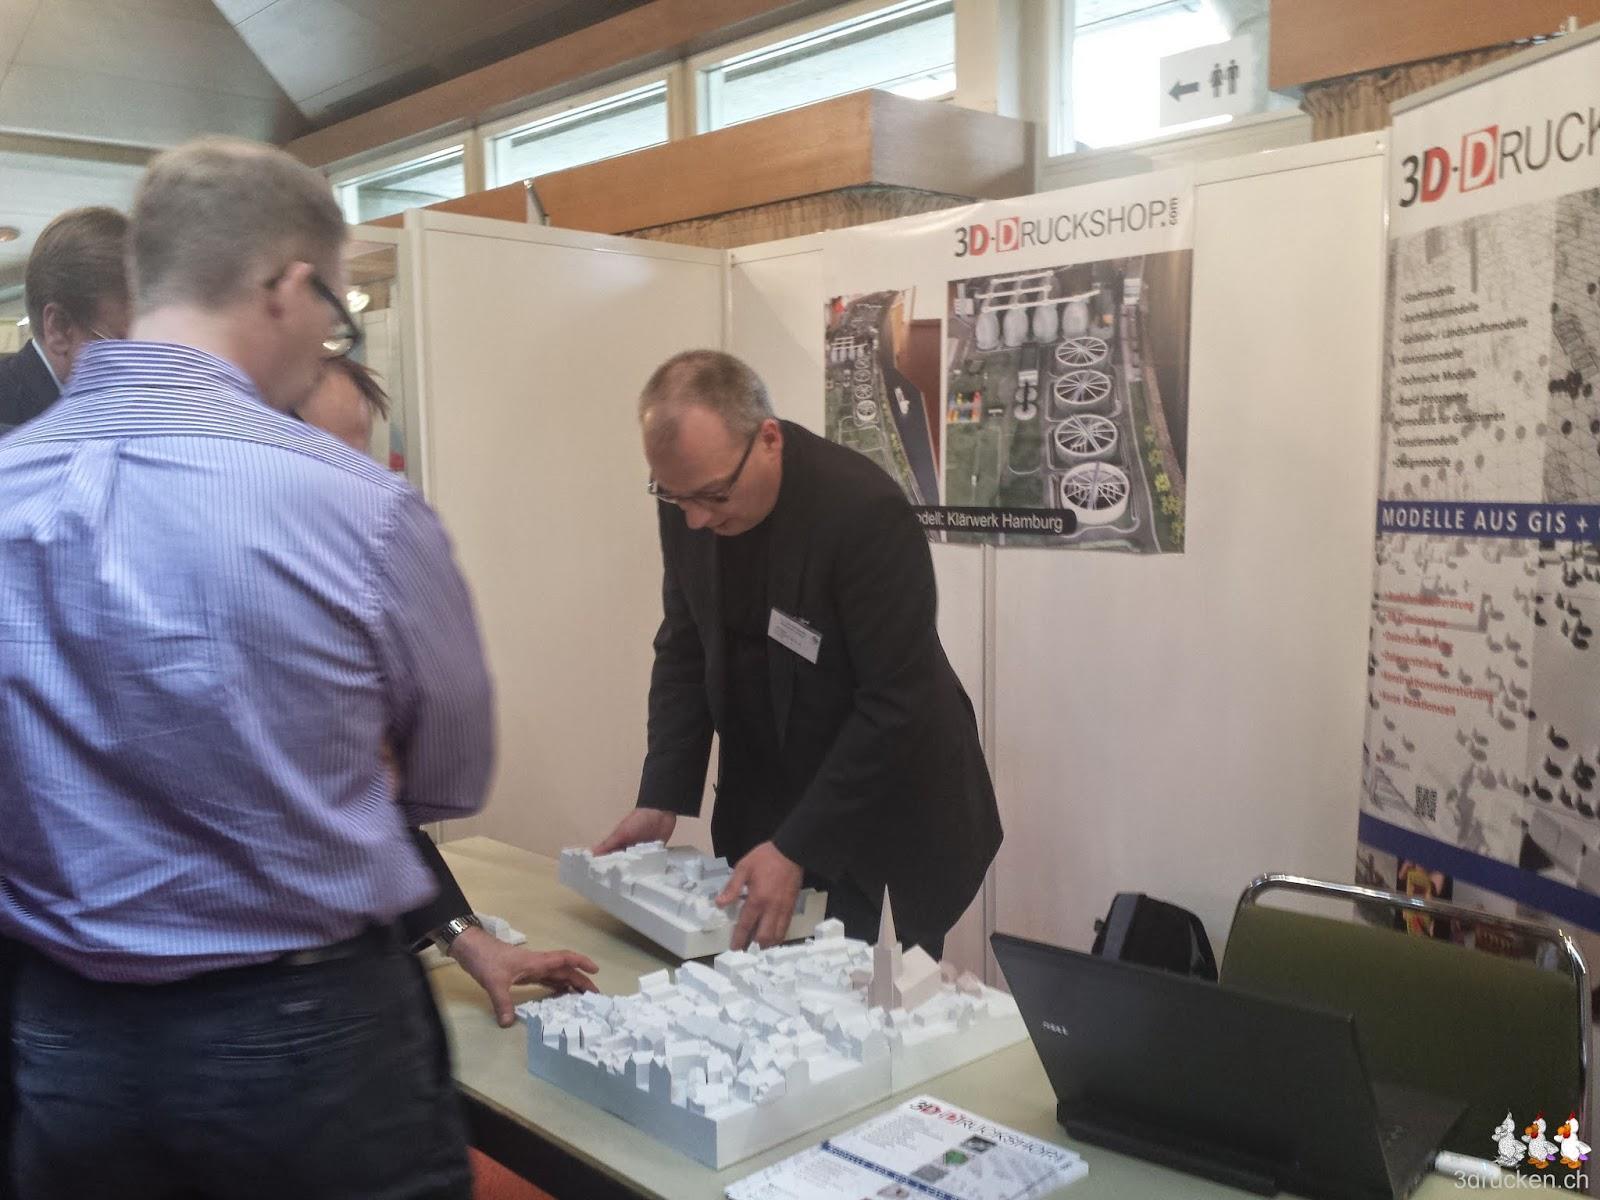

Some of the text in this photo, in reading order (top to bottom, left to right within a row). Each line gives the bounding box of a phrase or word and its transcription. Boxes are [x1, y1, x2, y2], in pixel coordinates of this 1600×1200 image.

[946, 511, 1000, 528] Klärwerk
[1002, 513, 1064, 533] Hamburg
[1382, 507, 1465, 530] MODELLE
[1474, 510, 1517, 532] AUS
[1528, 511, 1567, 534] GIS
